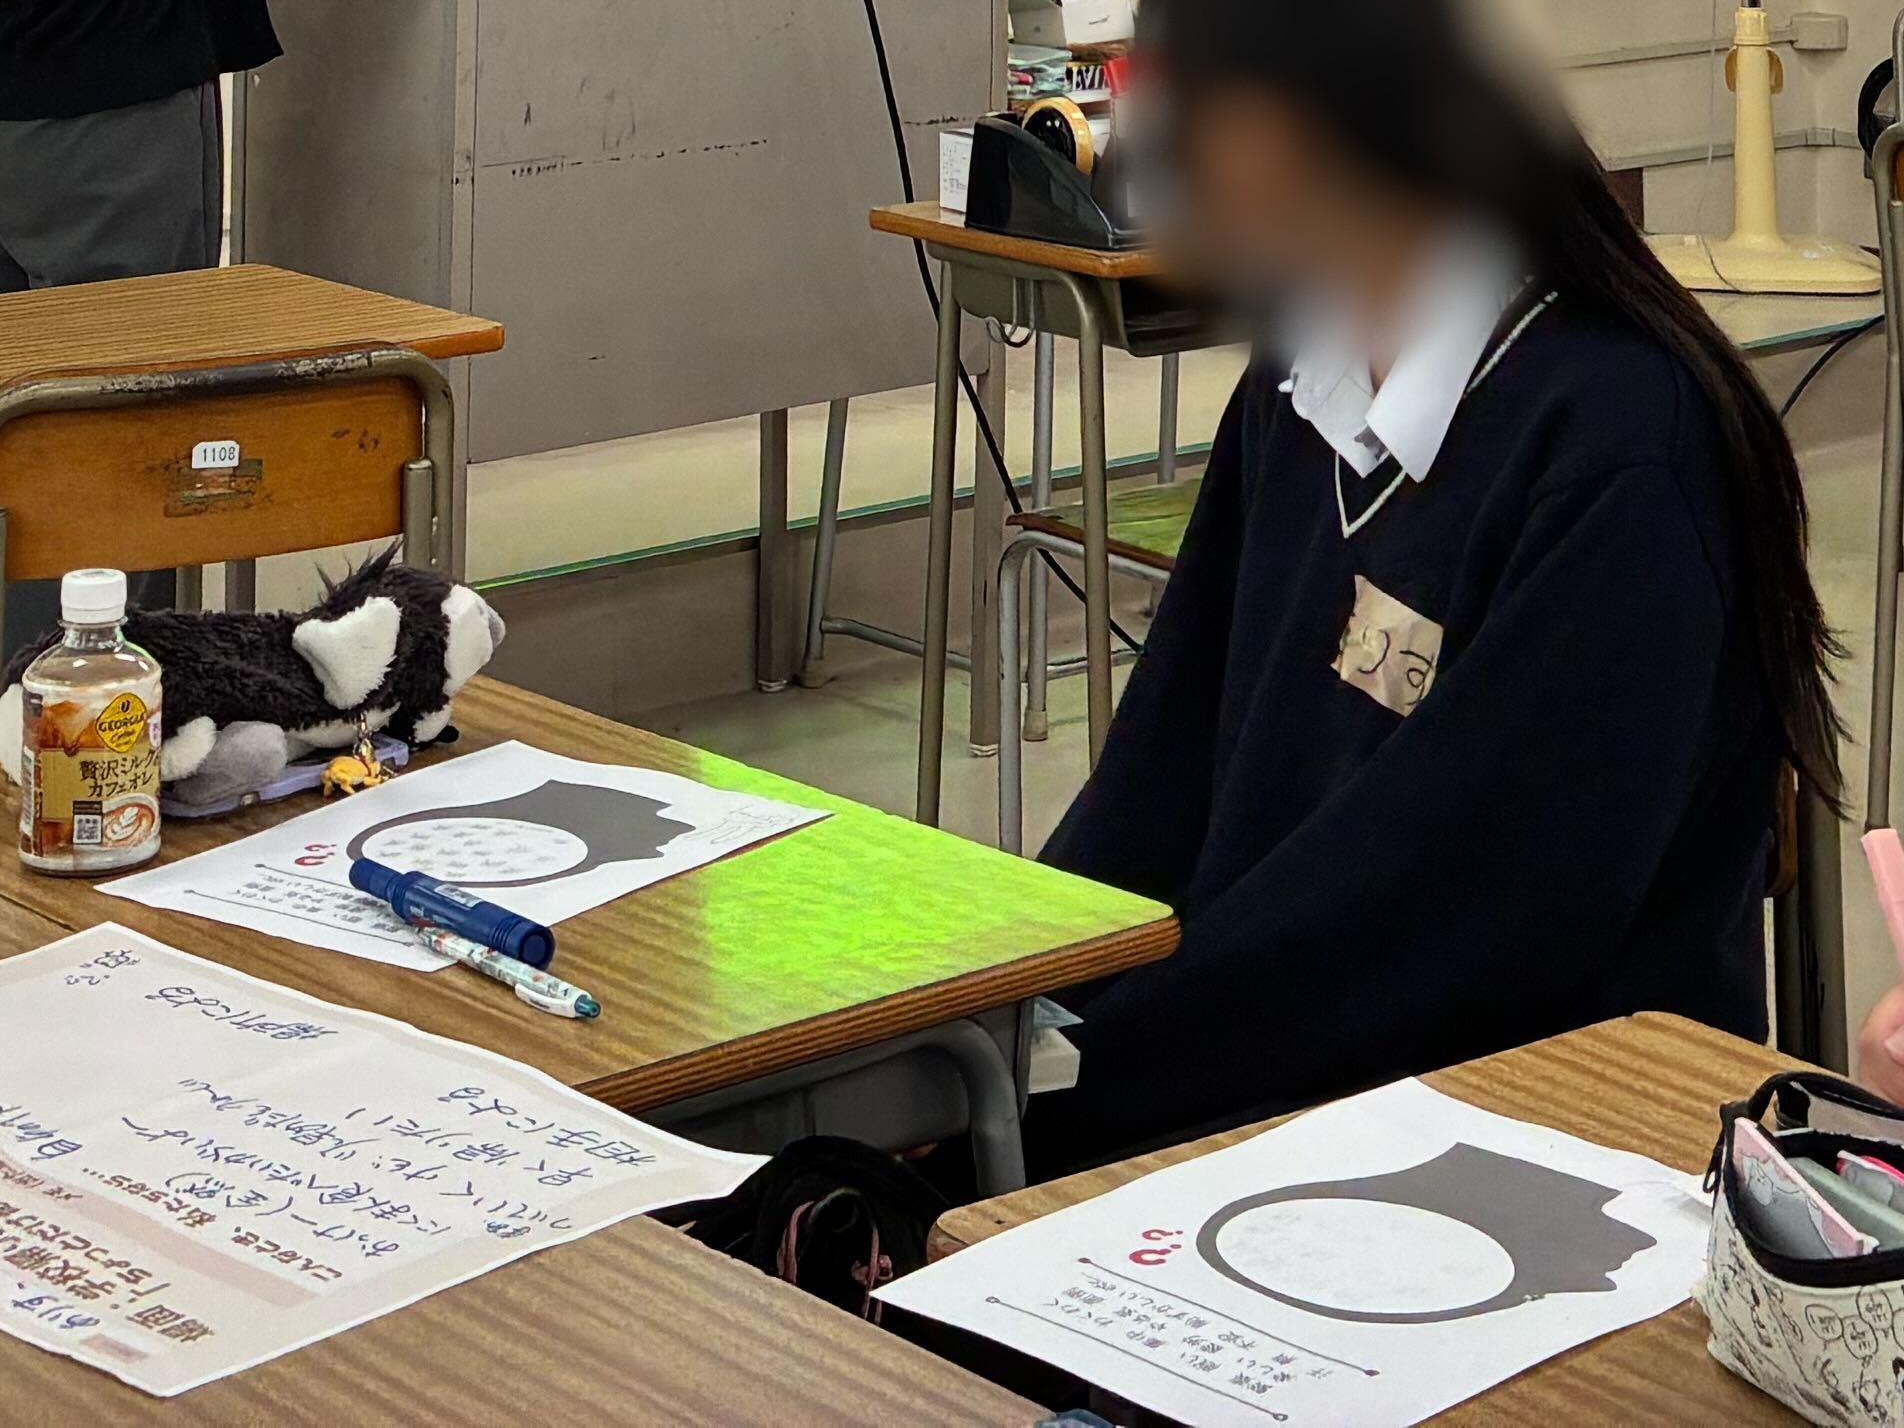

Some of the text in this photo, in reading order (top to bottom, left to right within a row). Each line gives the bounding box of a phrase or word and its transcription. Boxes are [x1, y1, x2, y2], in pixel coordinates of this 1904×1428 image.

[202, 445, 236, 463] 1108
[88, 772, 153, 798] カフェオレ
[344, 1107, 593, 1185] 早く帰りたい
[437, 1086, 657, 1167] 相手による
